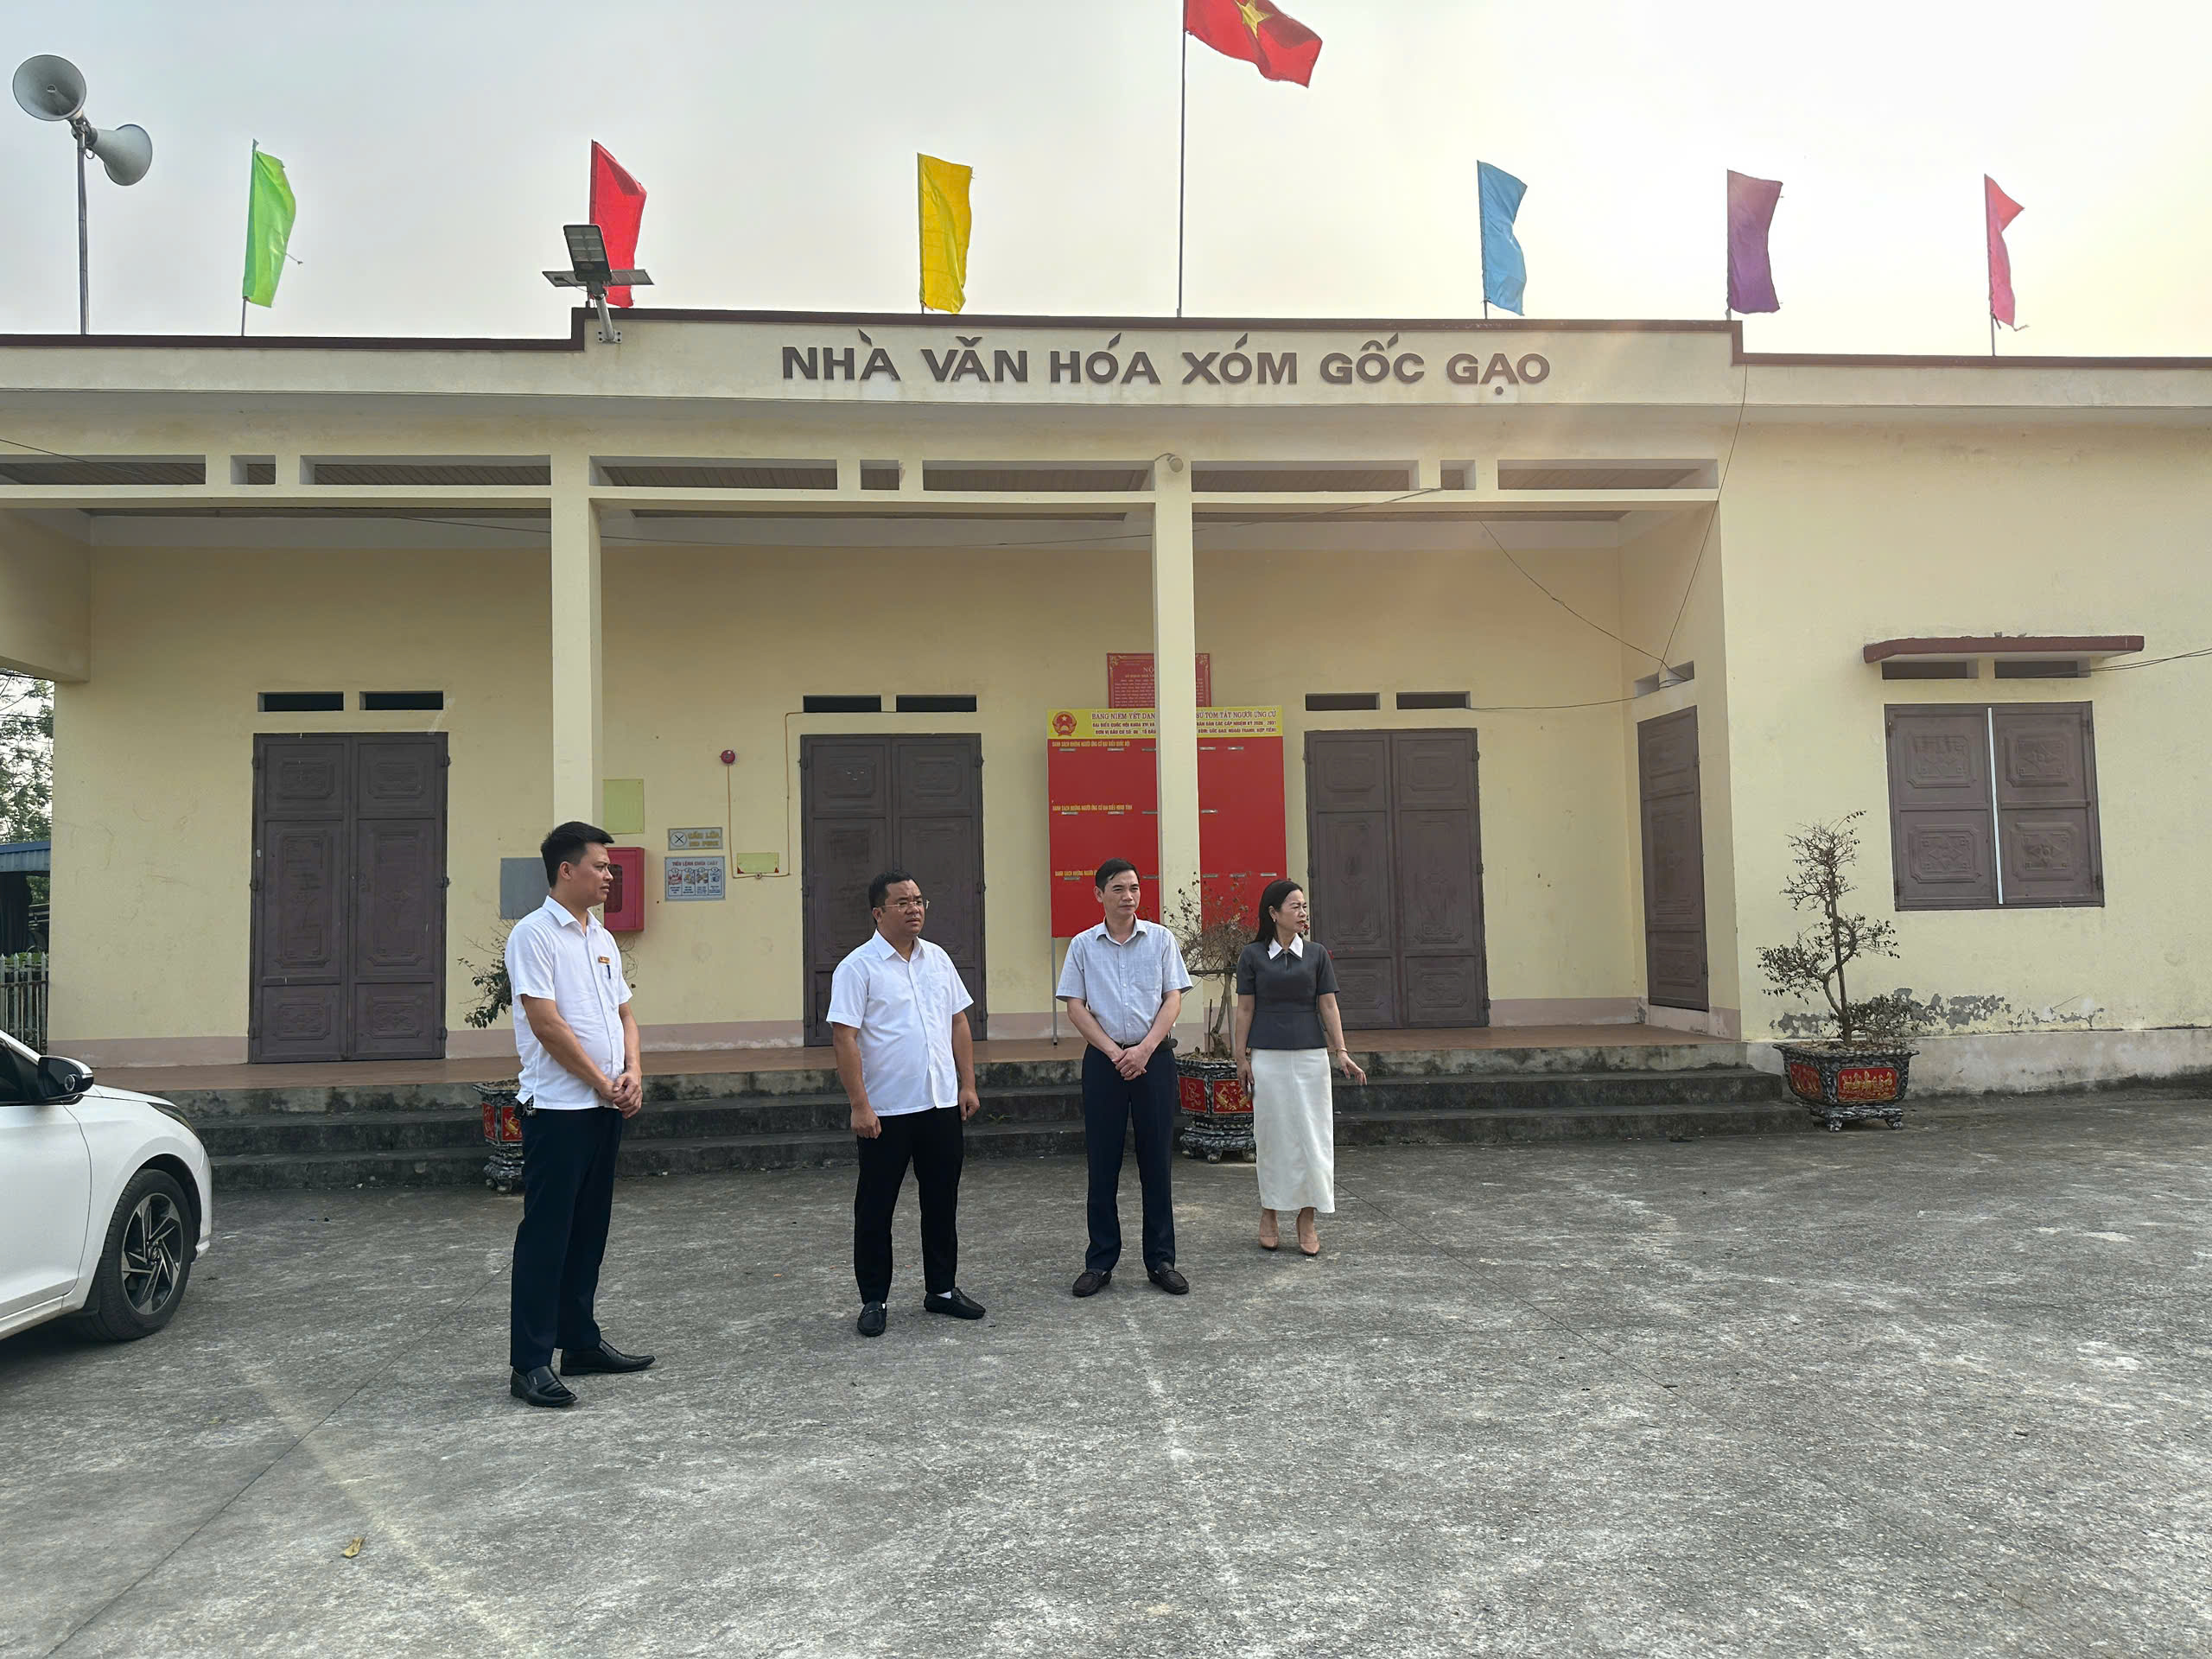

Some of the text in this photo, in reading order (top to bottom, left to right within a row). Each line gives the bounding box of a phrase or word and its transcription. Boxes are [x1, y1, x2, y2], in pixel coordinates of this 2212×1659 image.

[782, 328, 1551, 395] NHÀ VĂN HÓA XÓM GỐC GẠO
